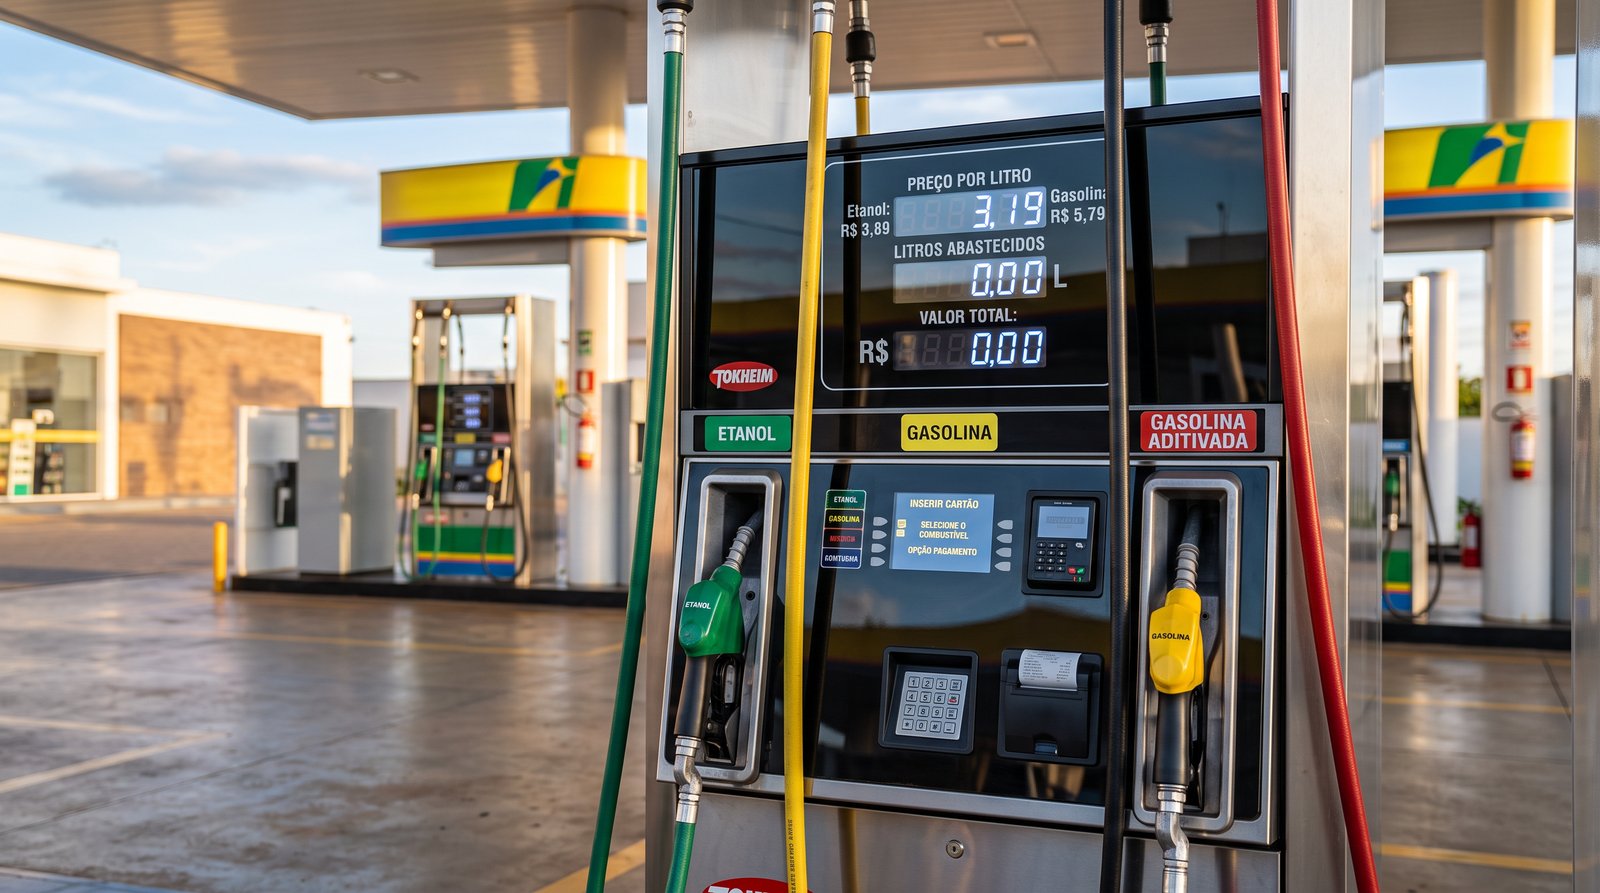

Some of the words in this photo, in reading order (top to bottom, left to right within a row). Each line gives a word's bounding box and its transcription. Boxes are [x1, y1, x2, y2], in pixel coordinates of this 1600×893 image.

[907, 174, 953, 193] PREÇO
[957, 171, 988, 188] POR
[990, 168, 1032, 185] LITRO
[847, 202, 890, 218] Etanol:
[973, 191, 1043, 229] 3,19
[1050, 207, 1069, 225] R$
[1074, 205, 1106, 225] 5,79
[840, 223, 858, 238] R$
[861, 221, 890, 238] 3,89
[894, 242, 943, 259] LITROS
[947, 236, 1045, 255] ABASTECIDOS
[971, 260, 1043, 298] 0,00
[1054, 264, 1067, 288] L
[920, 309, 965, 325] VALOR
[969, 308, 1017, 323] TOTAL:
[859, 338, 889, 365] R$
[970, 330, 1043, 367] 0,00
[712, 368, 774, 389] TOKHEIM
[1151, 413, 1246, 430] GASOLINA
[718, 425, 776, 441] ETANOL
[907, 424, 992, 441] GASOLINA
[1148, 432, 1248, 449] ADITIVADA
[833, 495, 858, 504] ETANOL
[910, 499, 943, 508] INSERIR
[945, 498, 979, 509] CARTÃO
[828, 515, 860, 523] GASOLINA
[920, 520, 959, 529] SELECIONE
[960, 521, 966, 529] O
[919, 530, 969, 540] COMBUSTÍVEL
[907, 545, 932, 556] OPÇÃO
[933, 546, 977, 556] PAGAMENTO
[685, 601, 711, 609] ETANOL
[1151, 632, 1190, 640] GASOLINA
